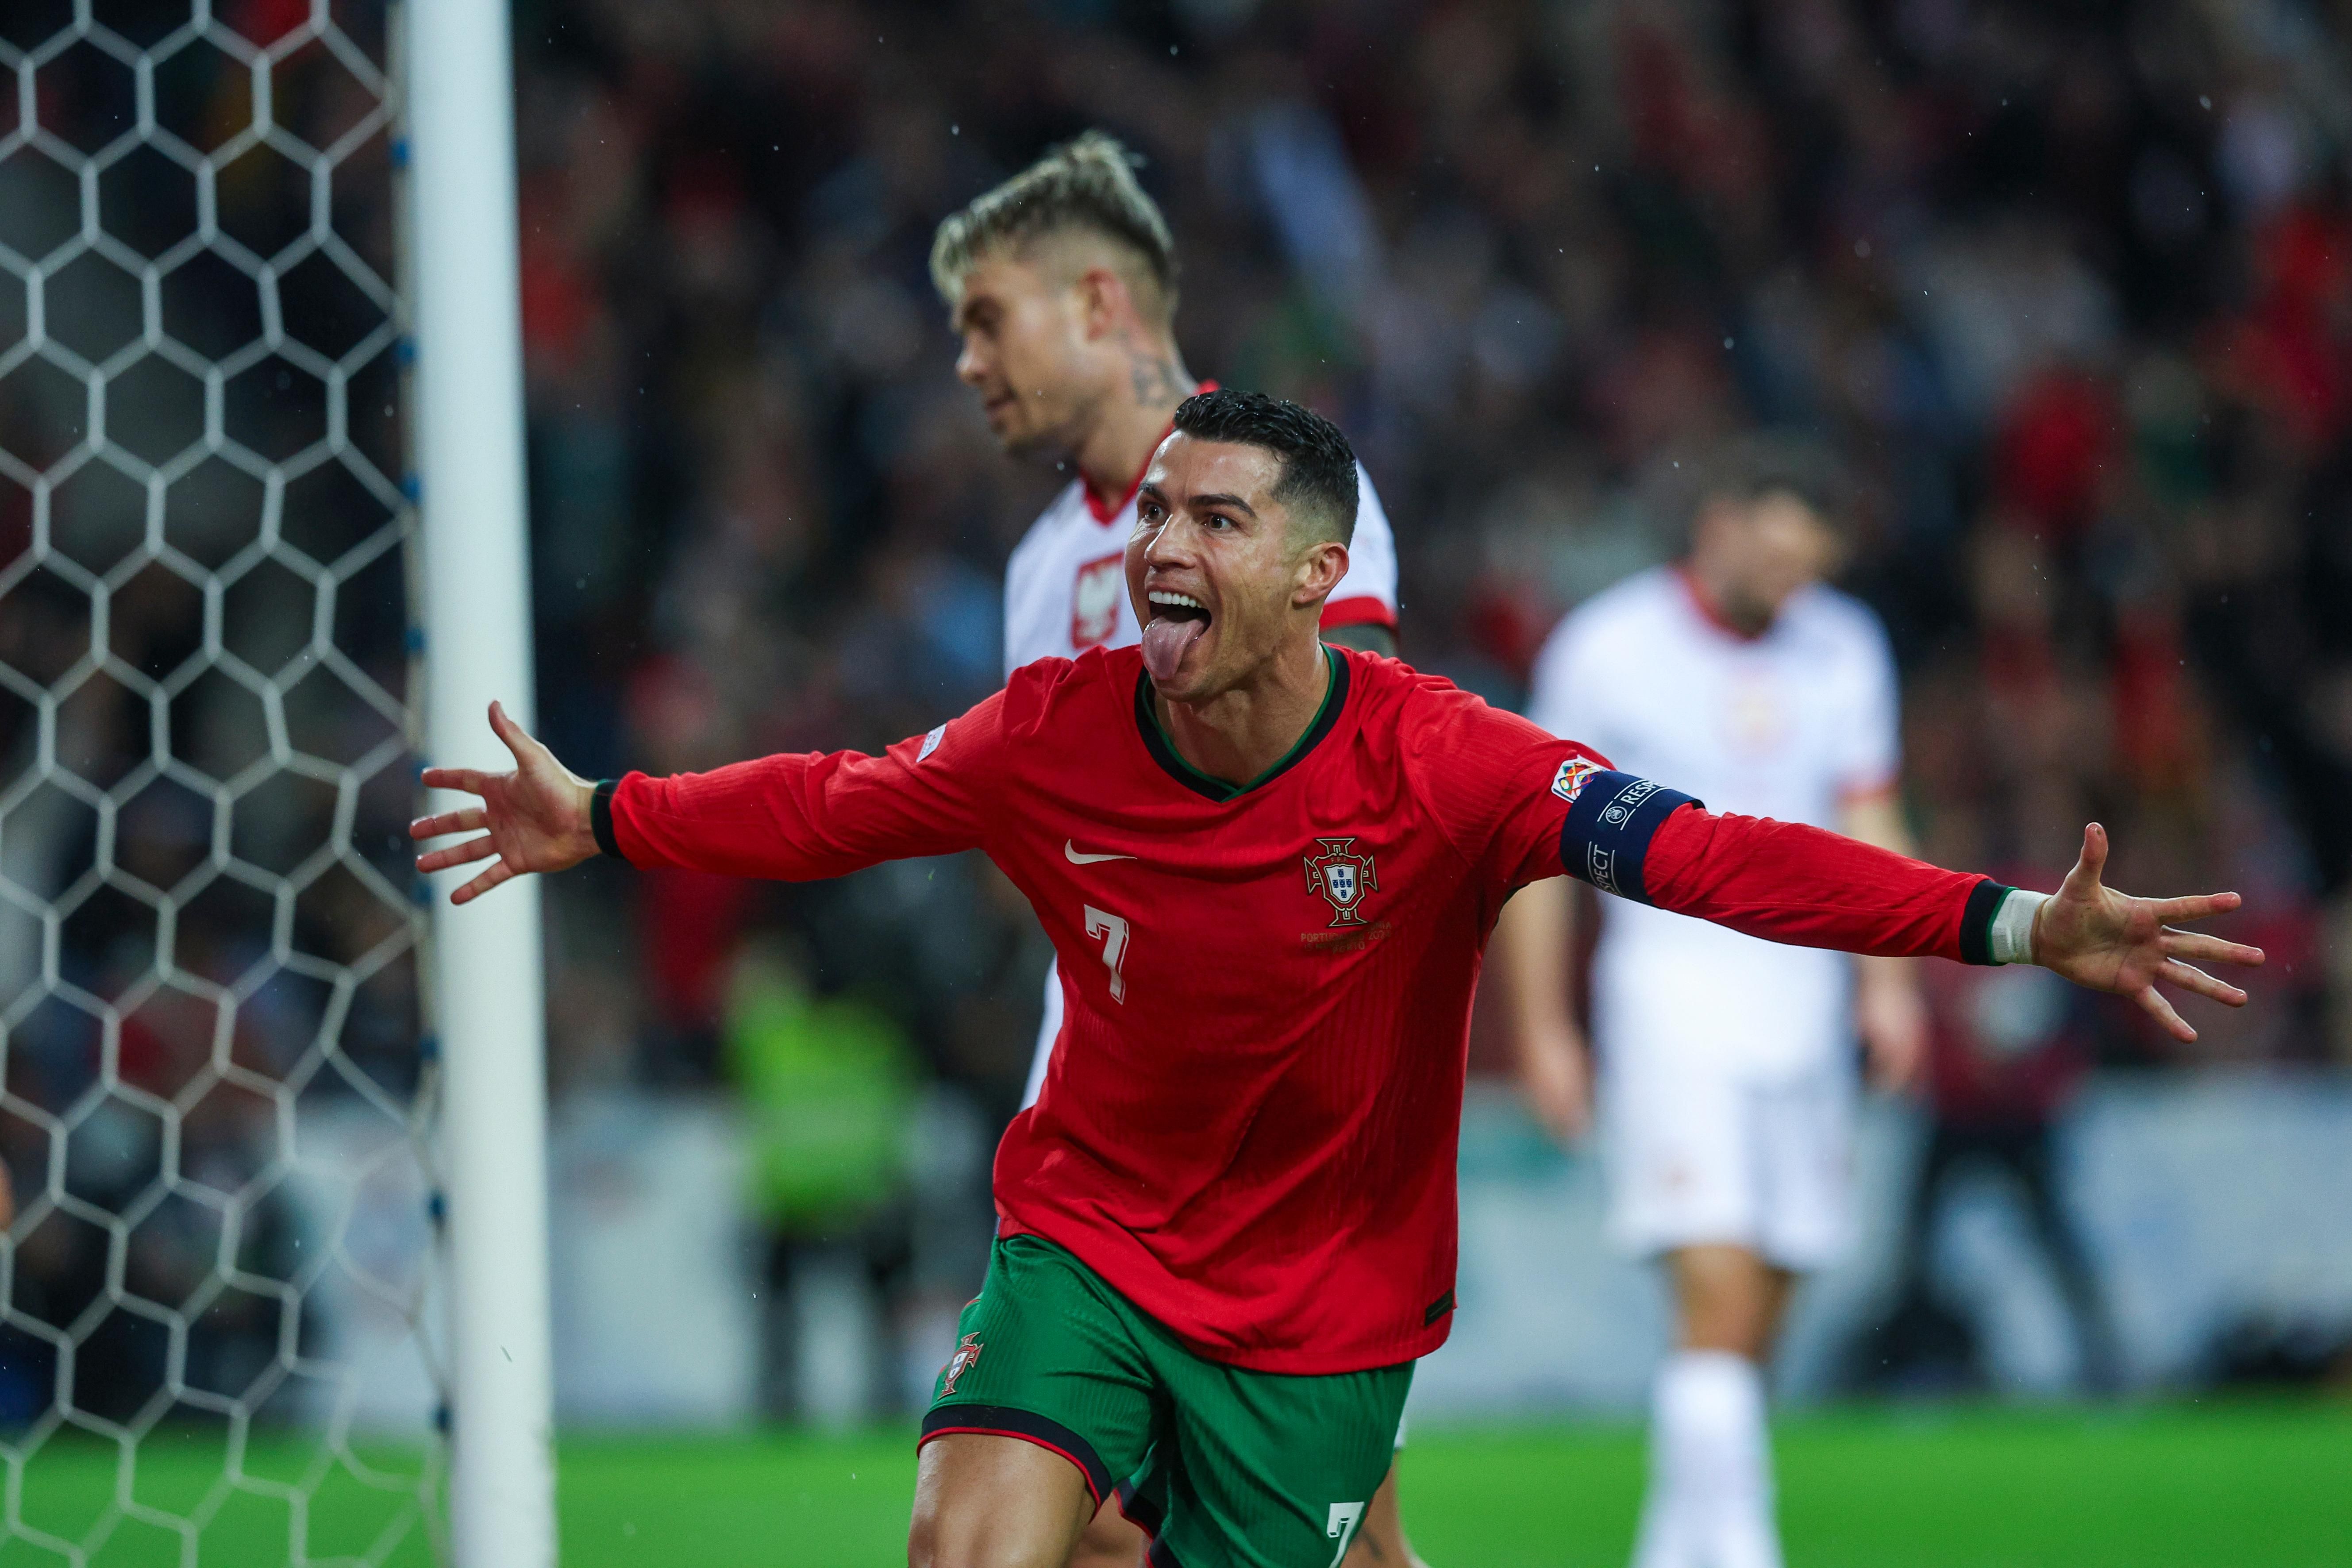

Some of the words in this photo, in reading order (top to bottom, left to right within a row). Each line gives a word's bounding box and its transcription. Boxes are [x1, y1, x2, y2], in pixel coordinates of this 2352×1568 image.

[1621, 782, 1664, 805] RESP
[1593, 844, 1616, 892] SPECT
[1084, 904, 1129, 1005] 7
[1327, 1502, 1364, 1568] 7
